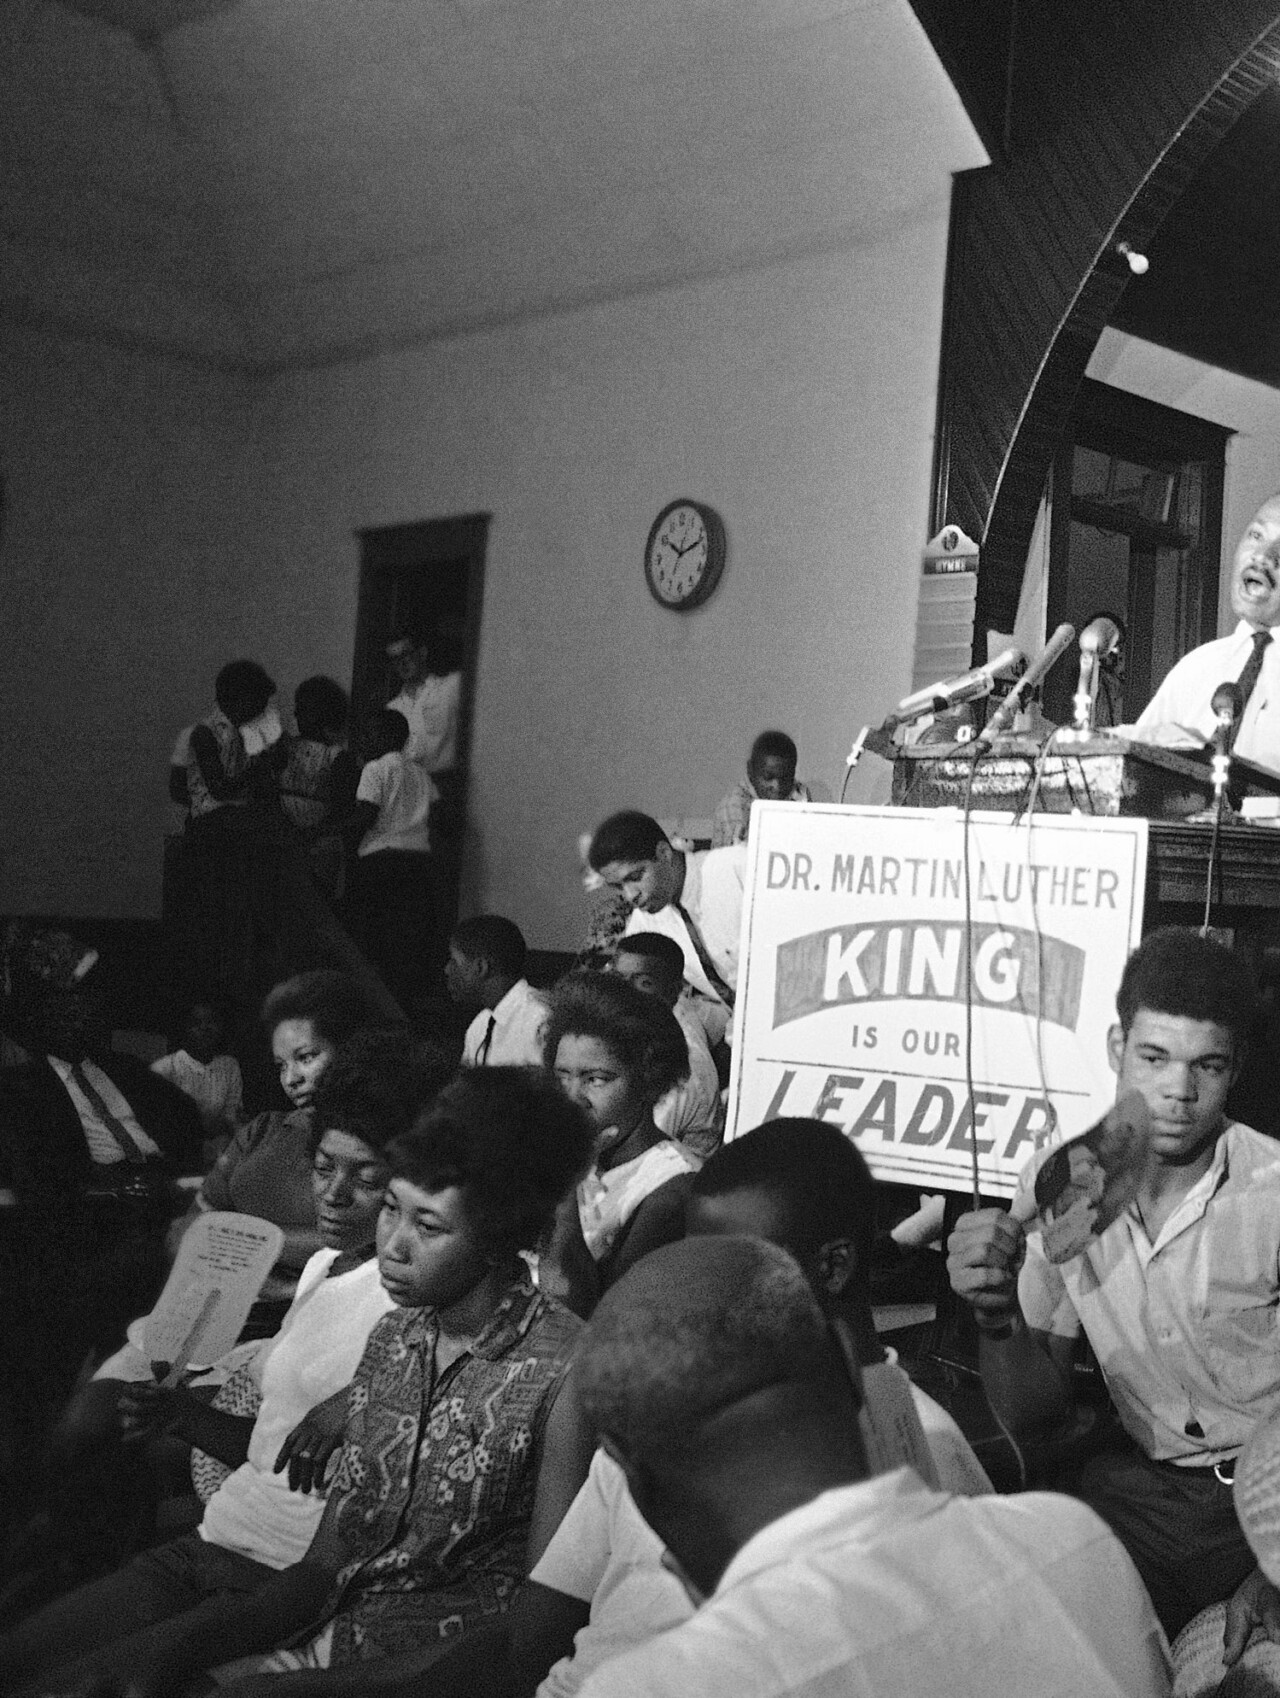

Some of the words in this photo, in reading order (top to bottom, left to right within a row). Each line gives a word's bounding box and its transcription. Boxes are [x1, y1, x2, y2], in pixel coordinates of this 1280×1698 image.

[766, 851, 820, 892] DR.
[831, 853, 962, 899] MARTIN
[977, 860, 1120, 908] LUTHER
[823, 925, 1021, 1003] KING
[851, 1024, 878, 1049] IS
[902, 1029, 960, 1057] OUR
[762, 1070, 1058, 1159] LEADER
